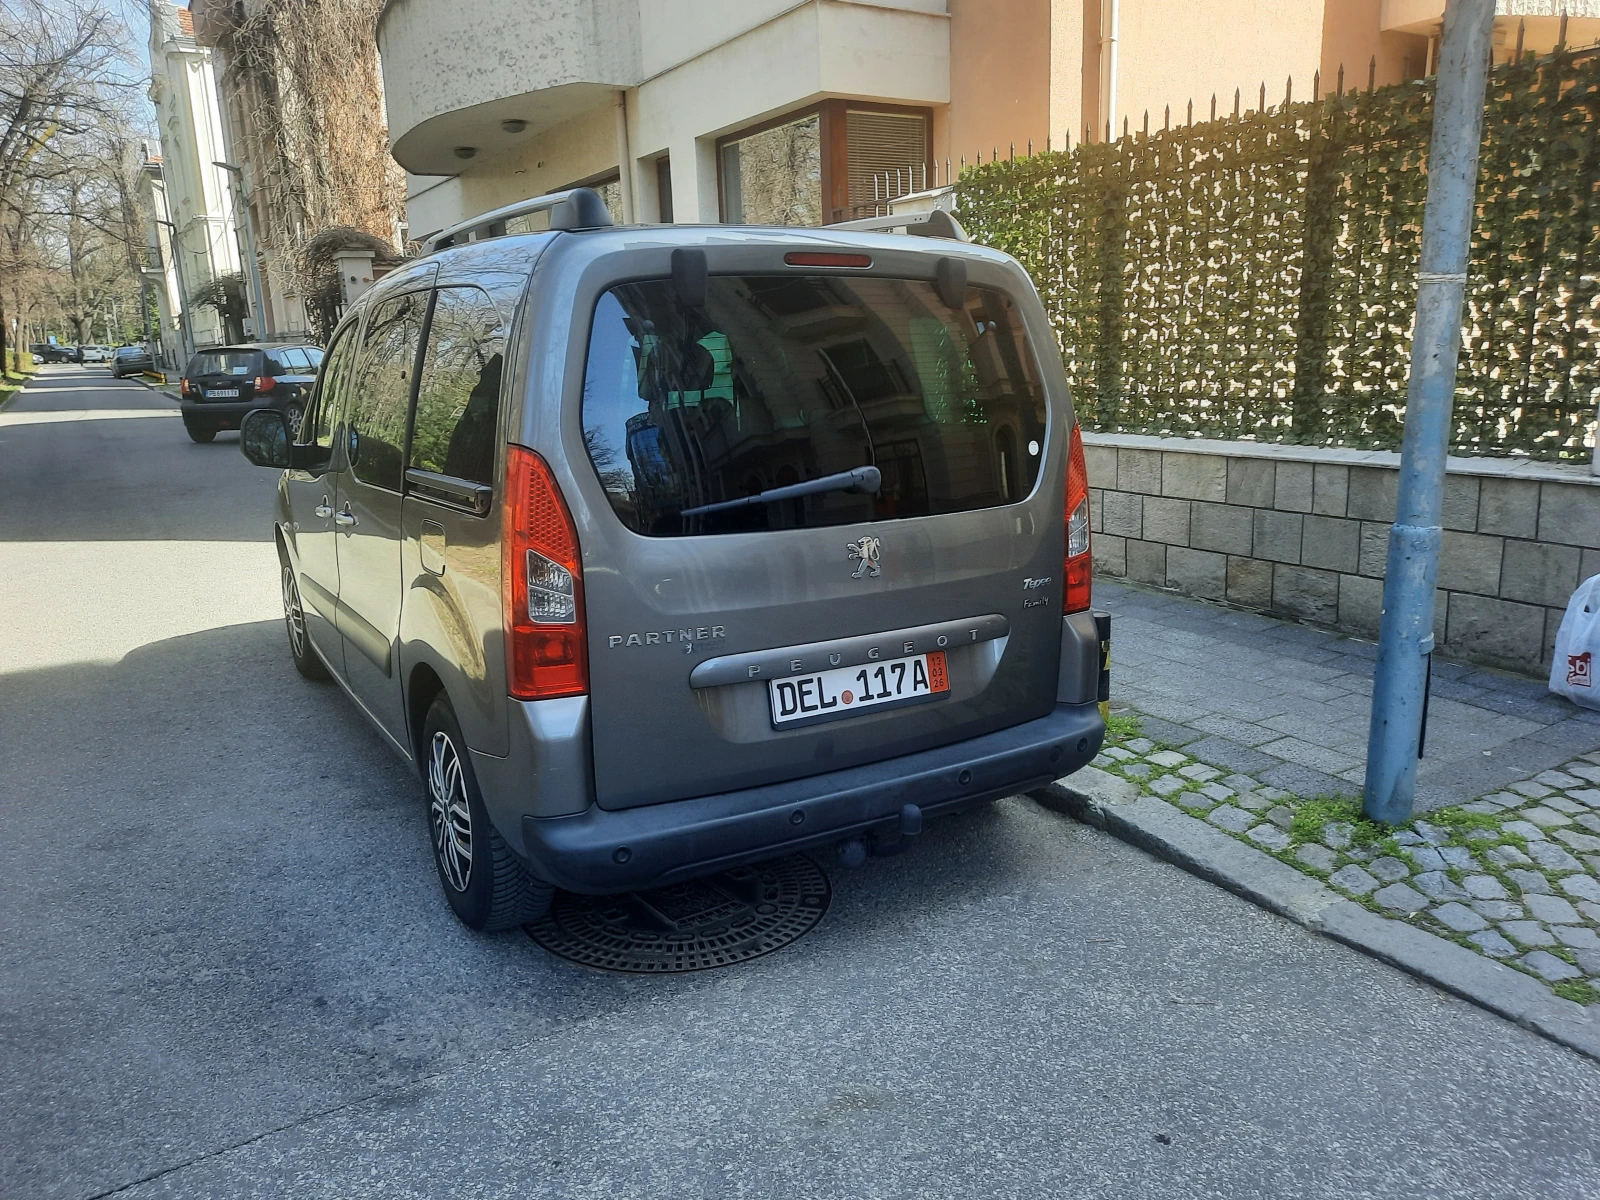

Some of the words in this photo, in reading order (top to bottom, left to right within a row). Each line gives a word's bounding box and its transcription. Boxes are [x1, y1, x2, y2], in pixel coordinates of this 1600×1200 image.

[1023, 576, 1052, 590] Tepee
[1023, 595, 1049, 609] Family
[608, 625, 726, 648] PARTNER
[748, 628, 979, 678] PEUGEOT
[931, 656, 942, 666] 13
[932, 667, 943, 677] 03
[933, 678, 945, 688] 26
[776, 676, 838, 716] DEL
